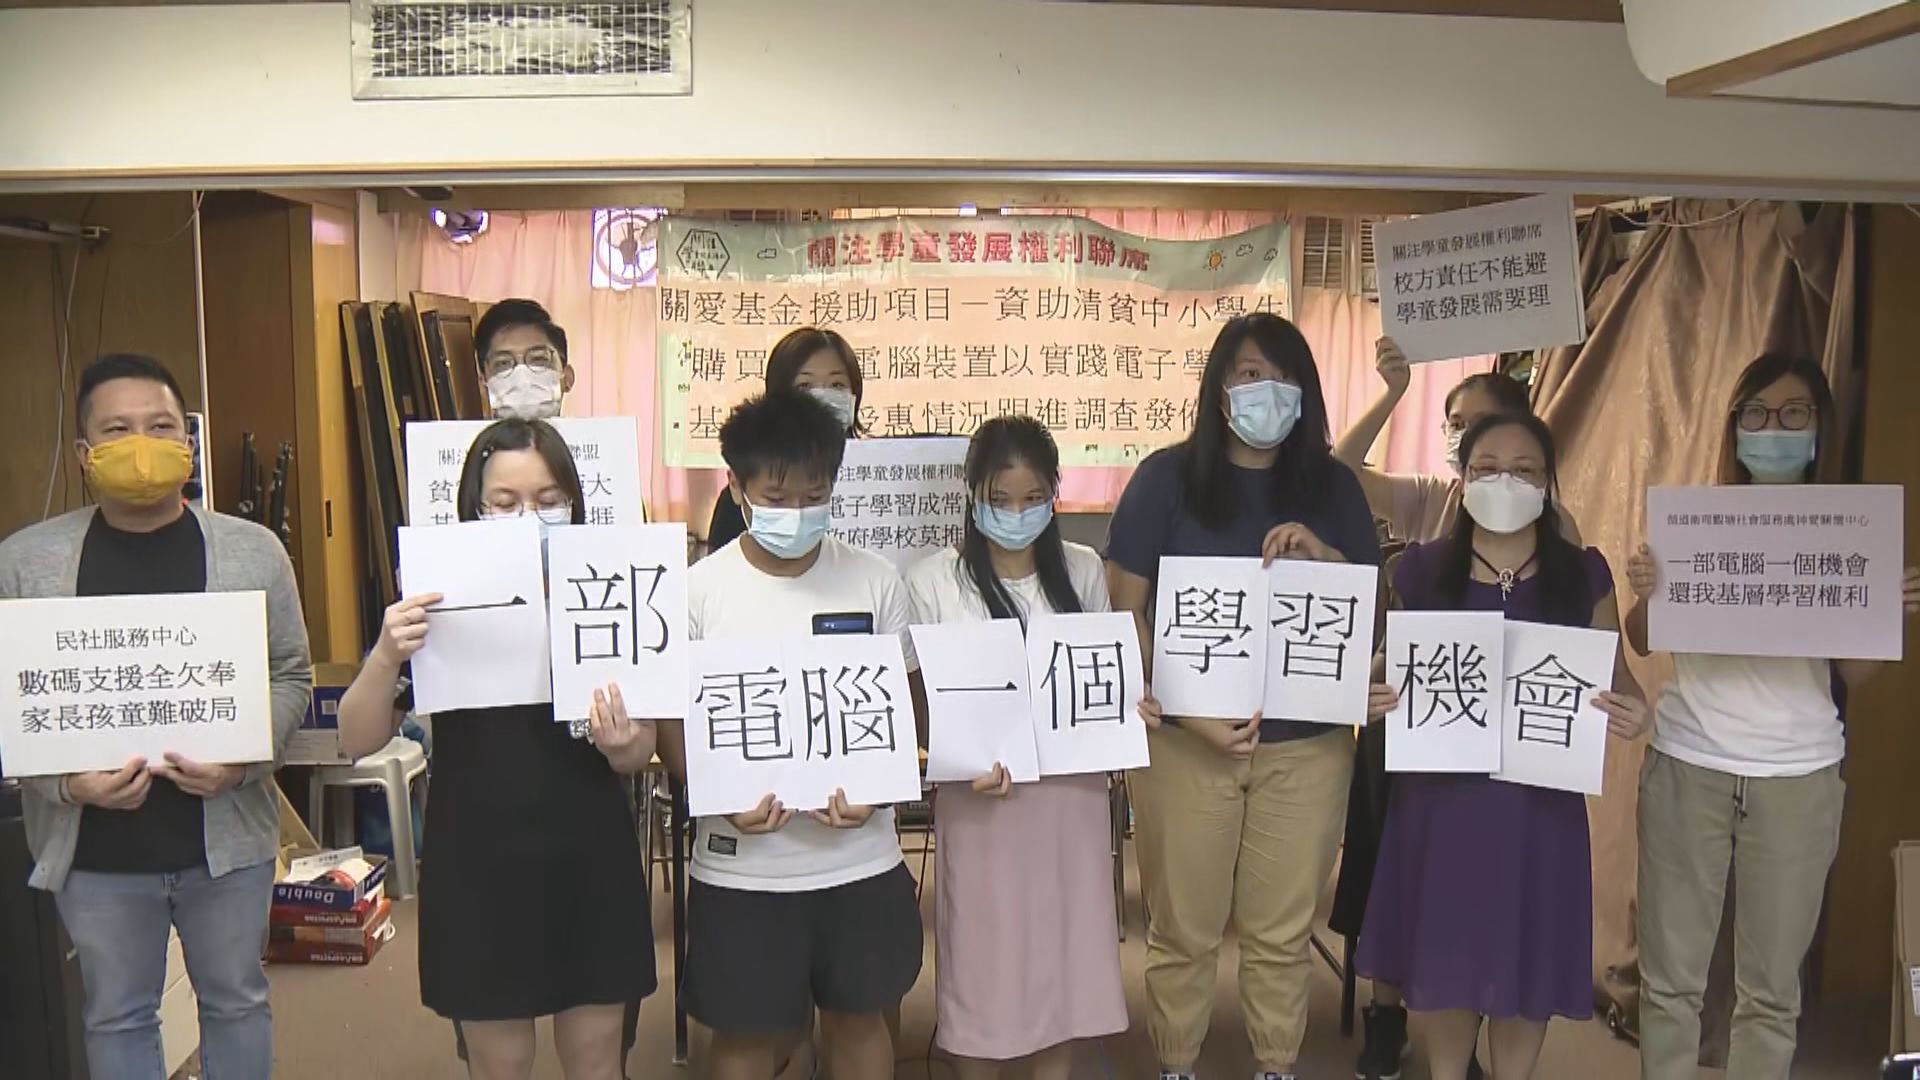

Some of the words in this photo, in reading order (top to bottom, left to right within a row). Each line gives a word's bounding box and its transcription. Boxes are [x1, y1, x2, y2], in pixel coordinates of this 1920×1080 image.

[807, 231, 1150, 271] 關注學童發展權利聯席
[1394, 252, 1548, 295] 校方責任不能避
[1396, 284, 1551, 325] 學童發展需要理
[691, 343, 1212, 382] 購買電腦裝置以實踐電子學
[1667, 551, 1870, 578] 一部電腦一個機會
[1667, 581, 1869, 608] 還我基層學習權利
[55, 626, 197, 651] 民社服務中心
[17, 659, 236, 697] 數碼支援全欠奉
[21, 696, 238, 733] 家長孩童難破局
[278, 886, 335, 904] Double
